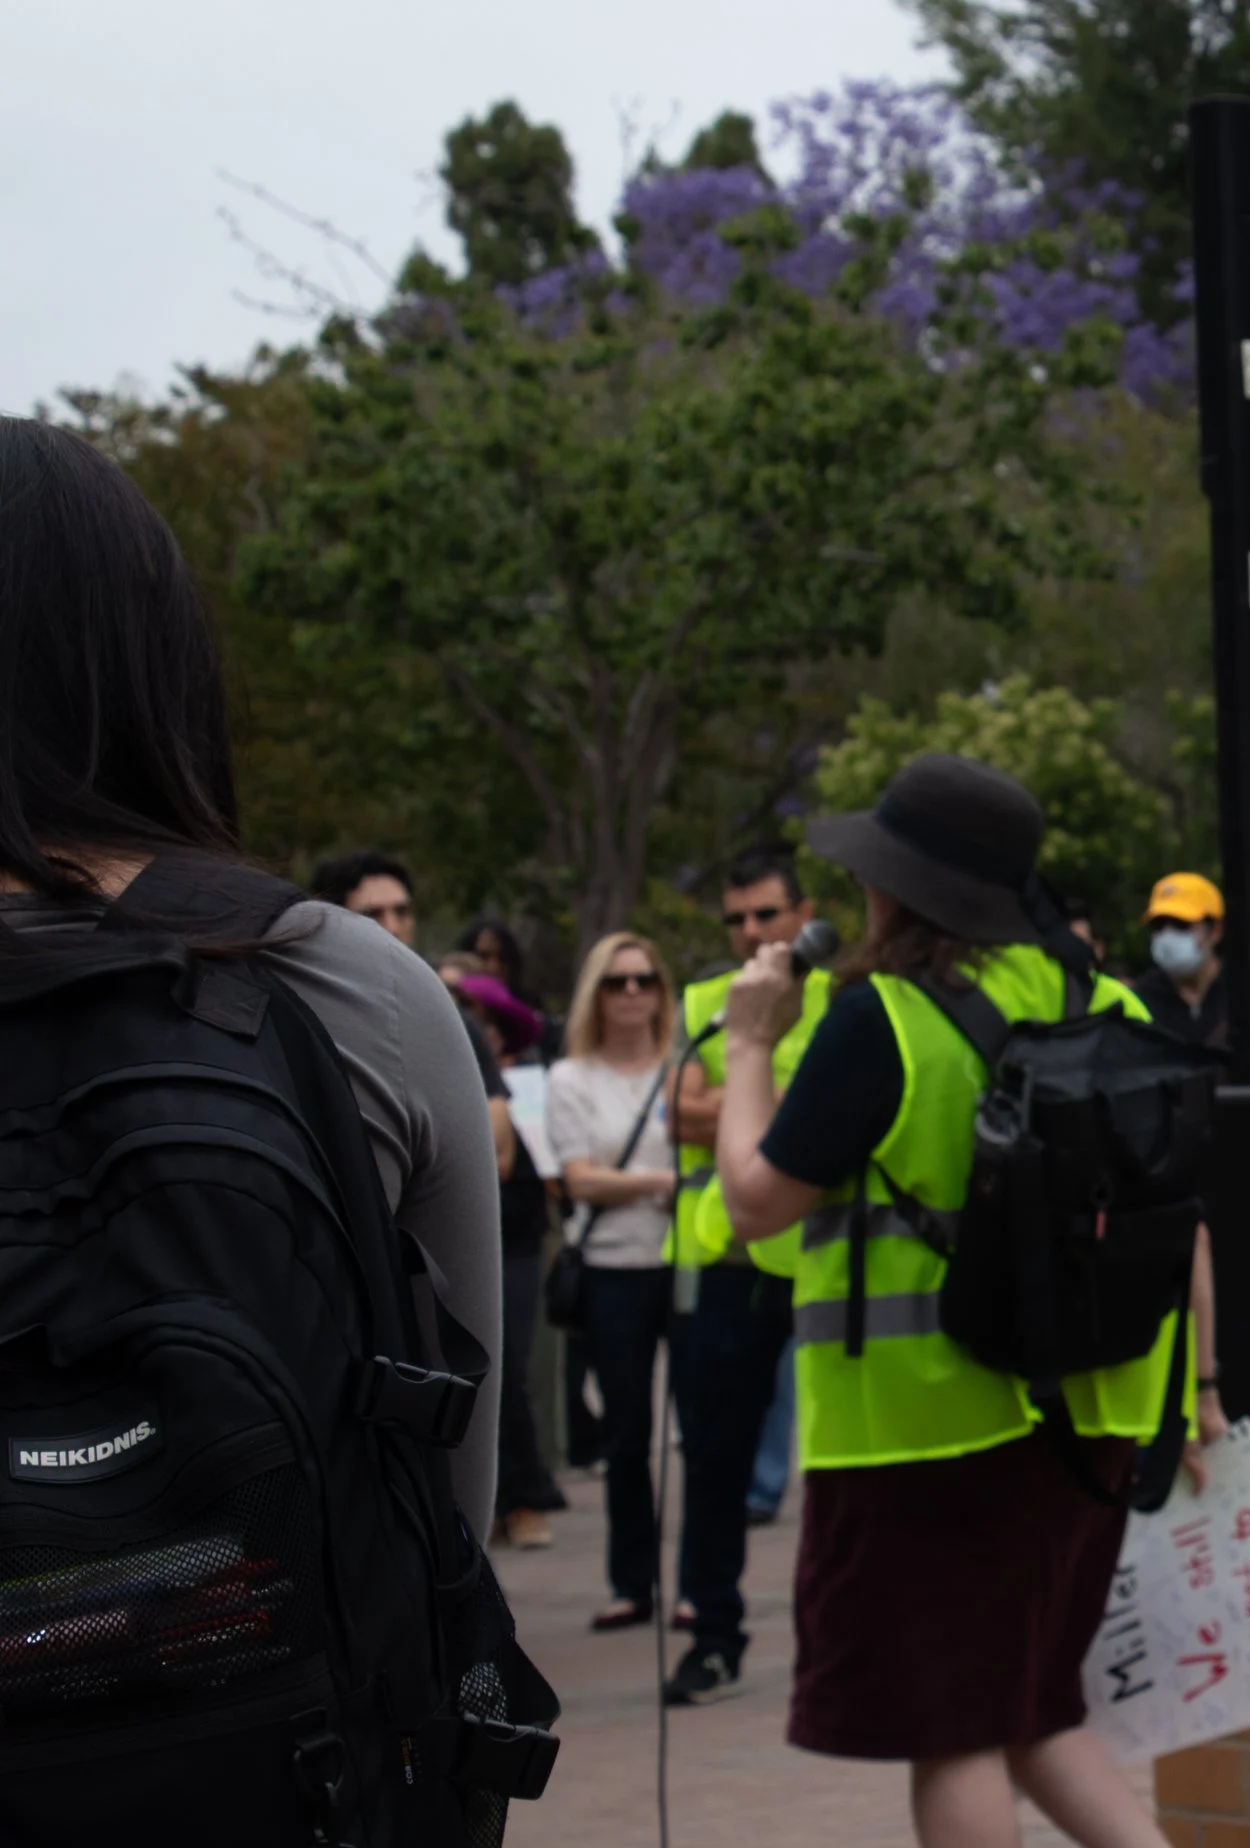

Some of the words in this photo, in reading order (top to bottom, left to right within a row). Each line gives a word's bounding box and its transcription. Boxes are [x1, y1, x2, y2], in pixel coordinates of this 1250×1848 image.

[20, 1421, 150, 1466] NEIKIDNIS
[1170, 1517, 1214, 1590] still
[1175, 1619, 1229, 1702] We
